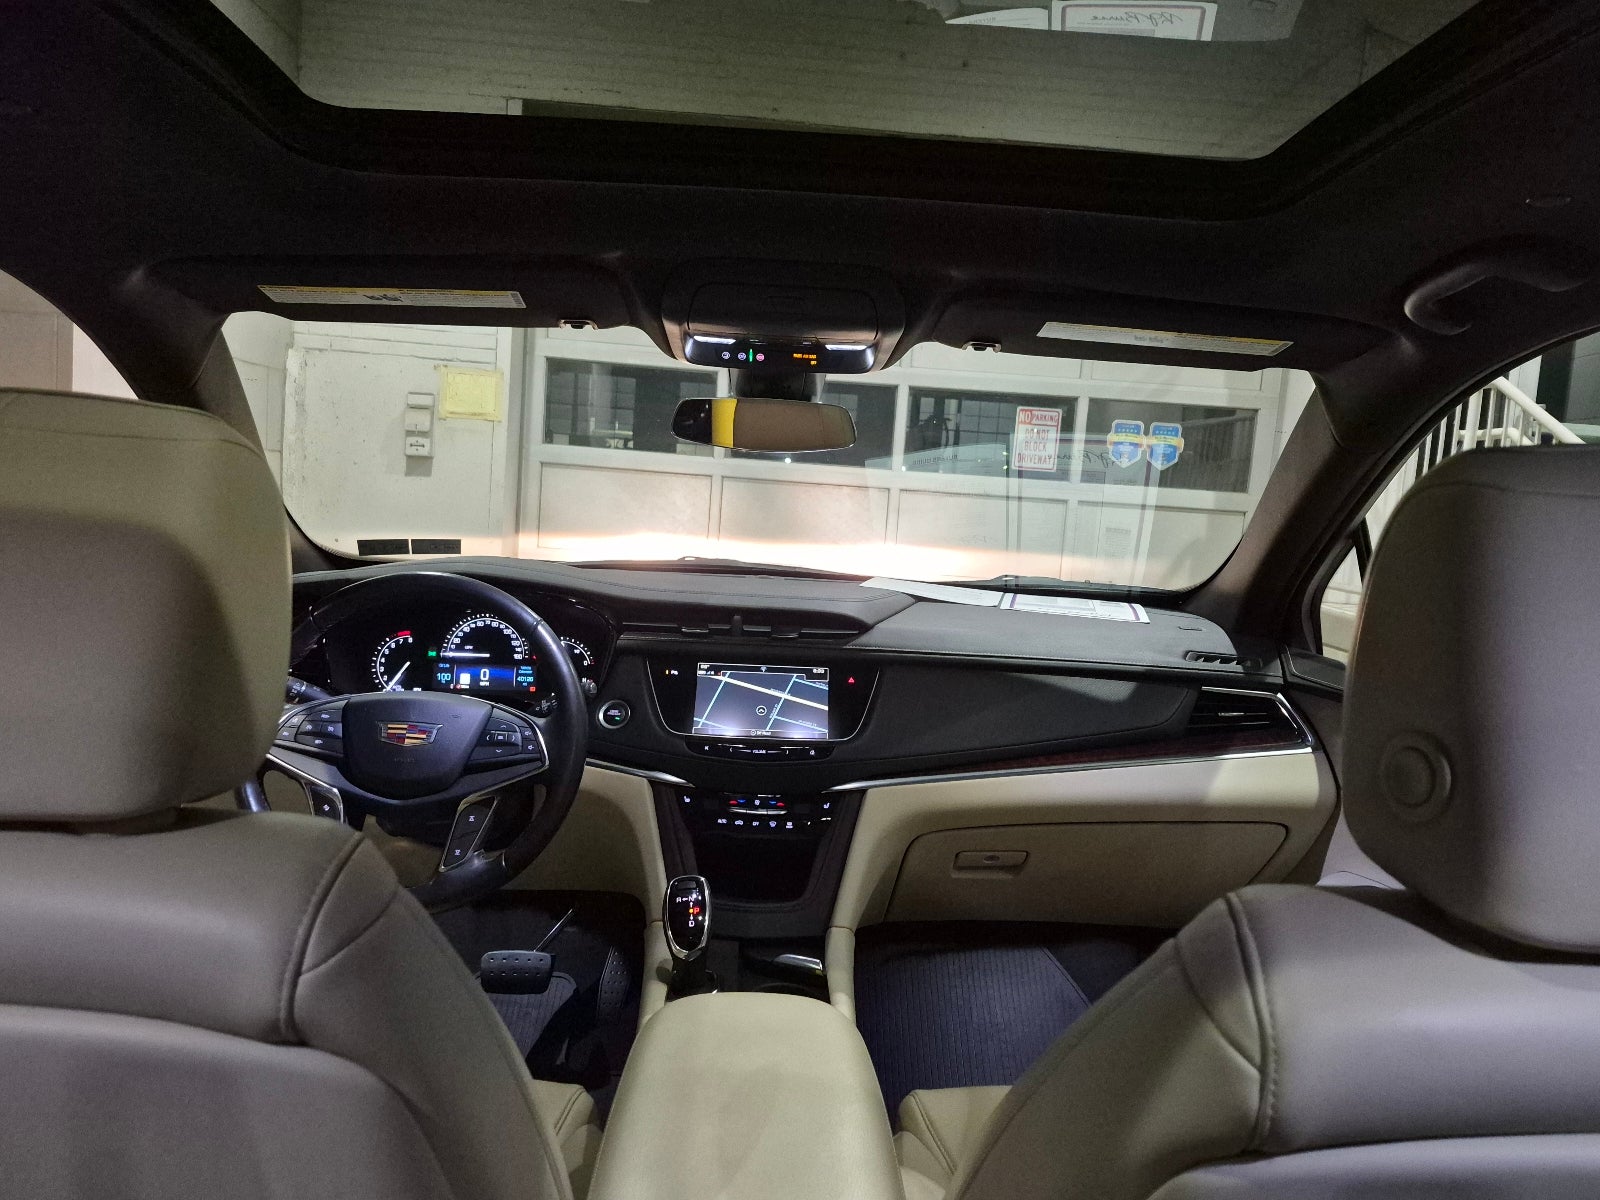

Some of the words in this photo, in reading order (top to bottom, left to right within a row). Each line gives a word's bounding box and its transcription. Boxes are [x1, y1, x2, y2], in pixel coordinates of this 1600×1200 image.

[1019, 410, 1032, 423] NO
[1033, 411, 1058, 424] PARKING
[1025, 428, 1034, 439] DO
[1036, 428, 1050, 440] NOT
[1024, 440, 1048, 452] BLOCK
[1018, 453, 1052, 464] DRIVEWAY
[436, 672, 451, 681] 100
[480, 668, 490, 680] 0
